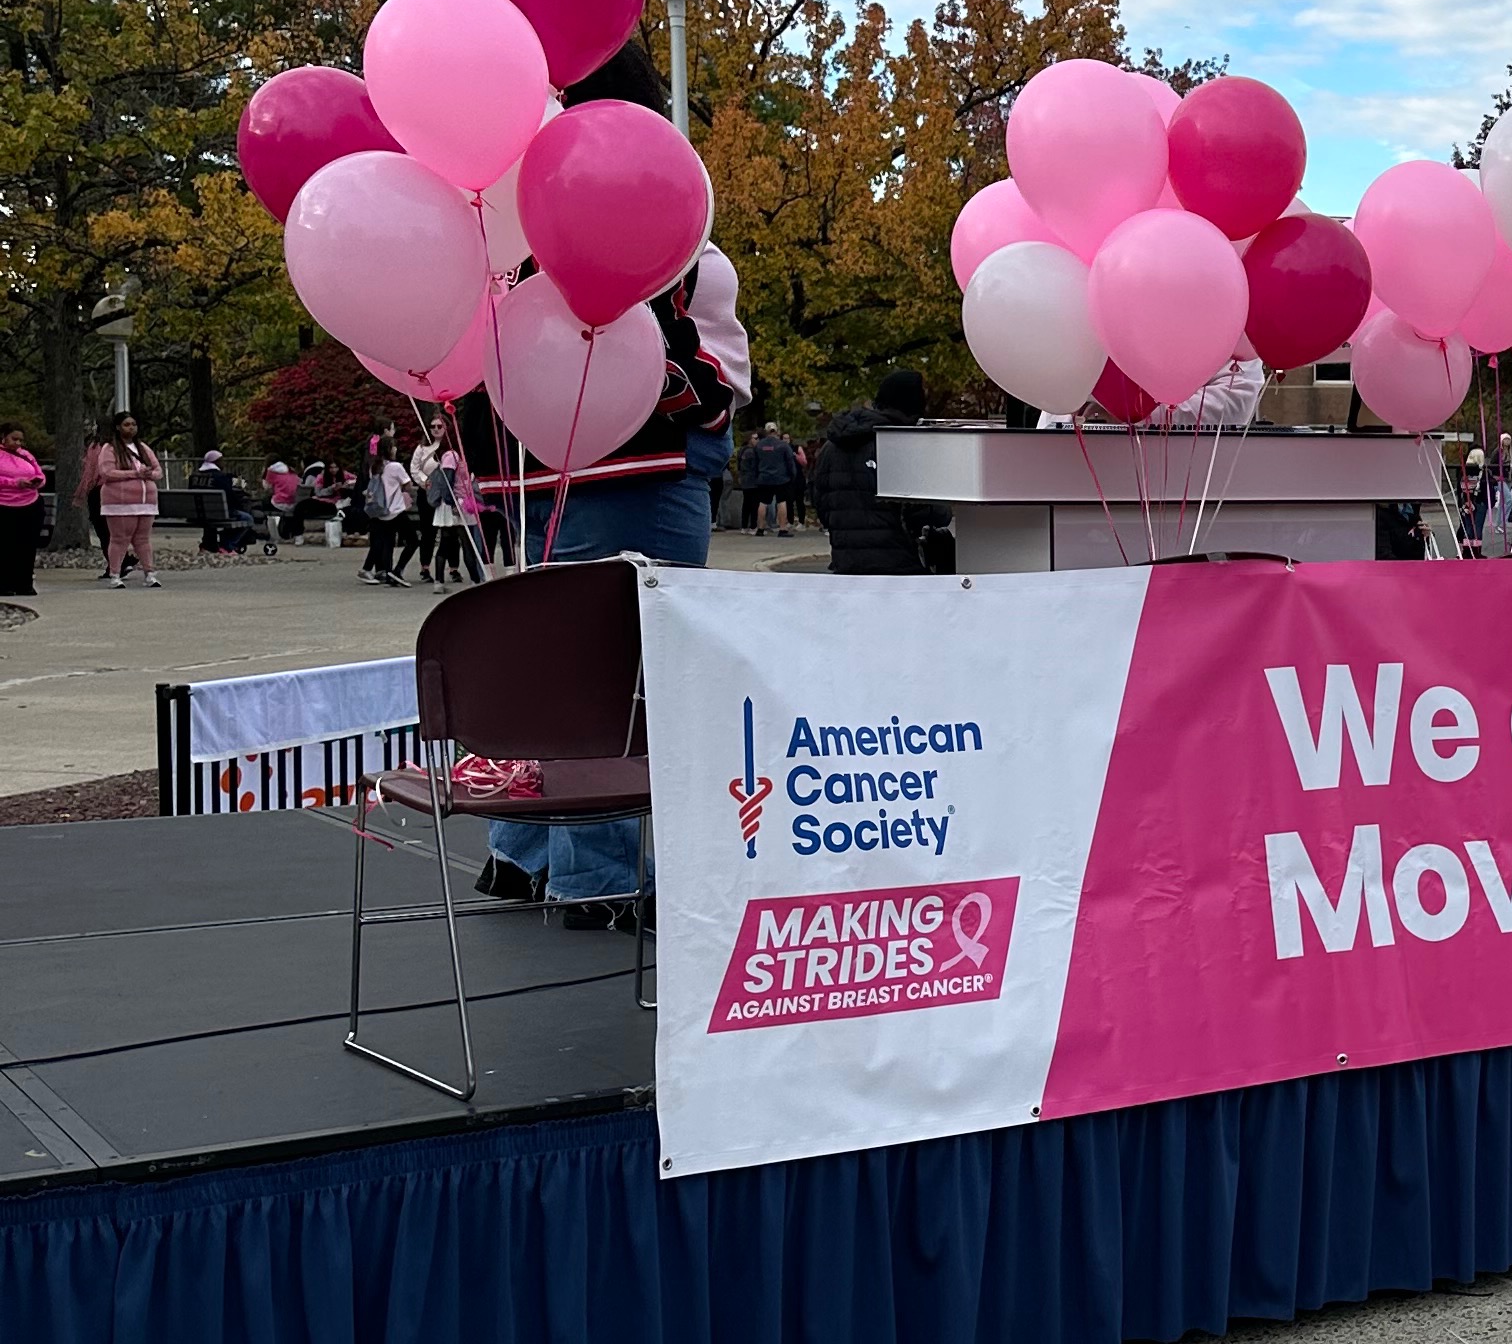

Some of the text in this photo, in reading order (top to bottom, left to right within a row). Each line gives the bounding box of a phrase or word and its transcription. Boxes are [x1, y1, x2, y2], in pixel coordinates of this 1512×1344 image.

[786, 715, 983, 758] American
[1264, 662, 1480, 791] We
[786, 764, 938, 806] Cancer
[756, 895, 944, 950] MAKING
[743, 937, 934, 994] STRIDES
[726, 993, 824, 1021] AGAINST
[827, 984, 903, 1010] BREAST
